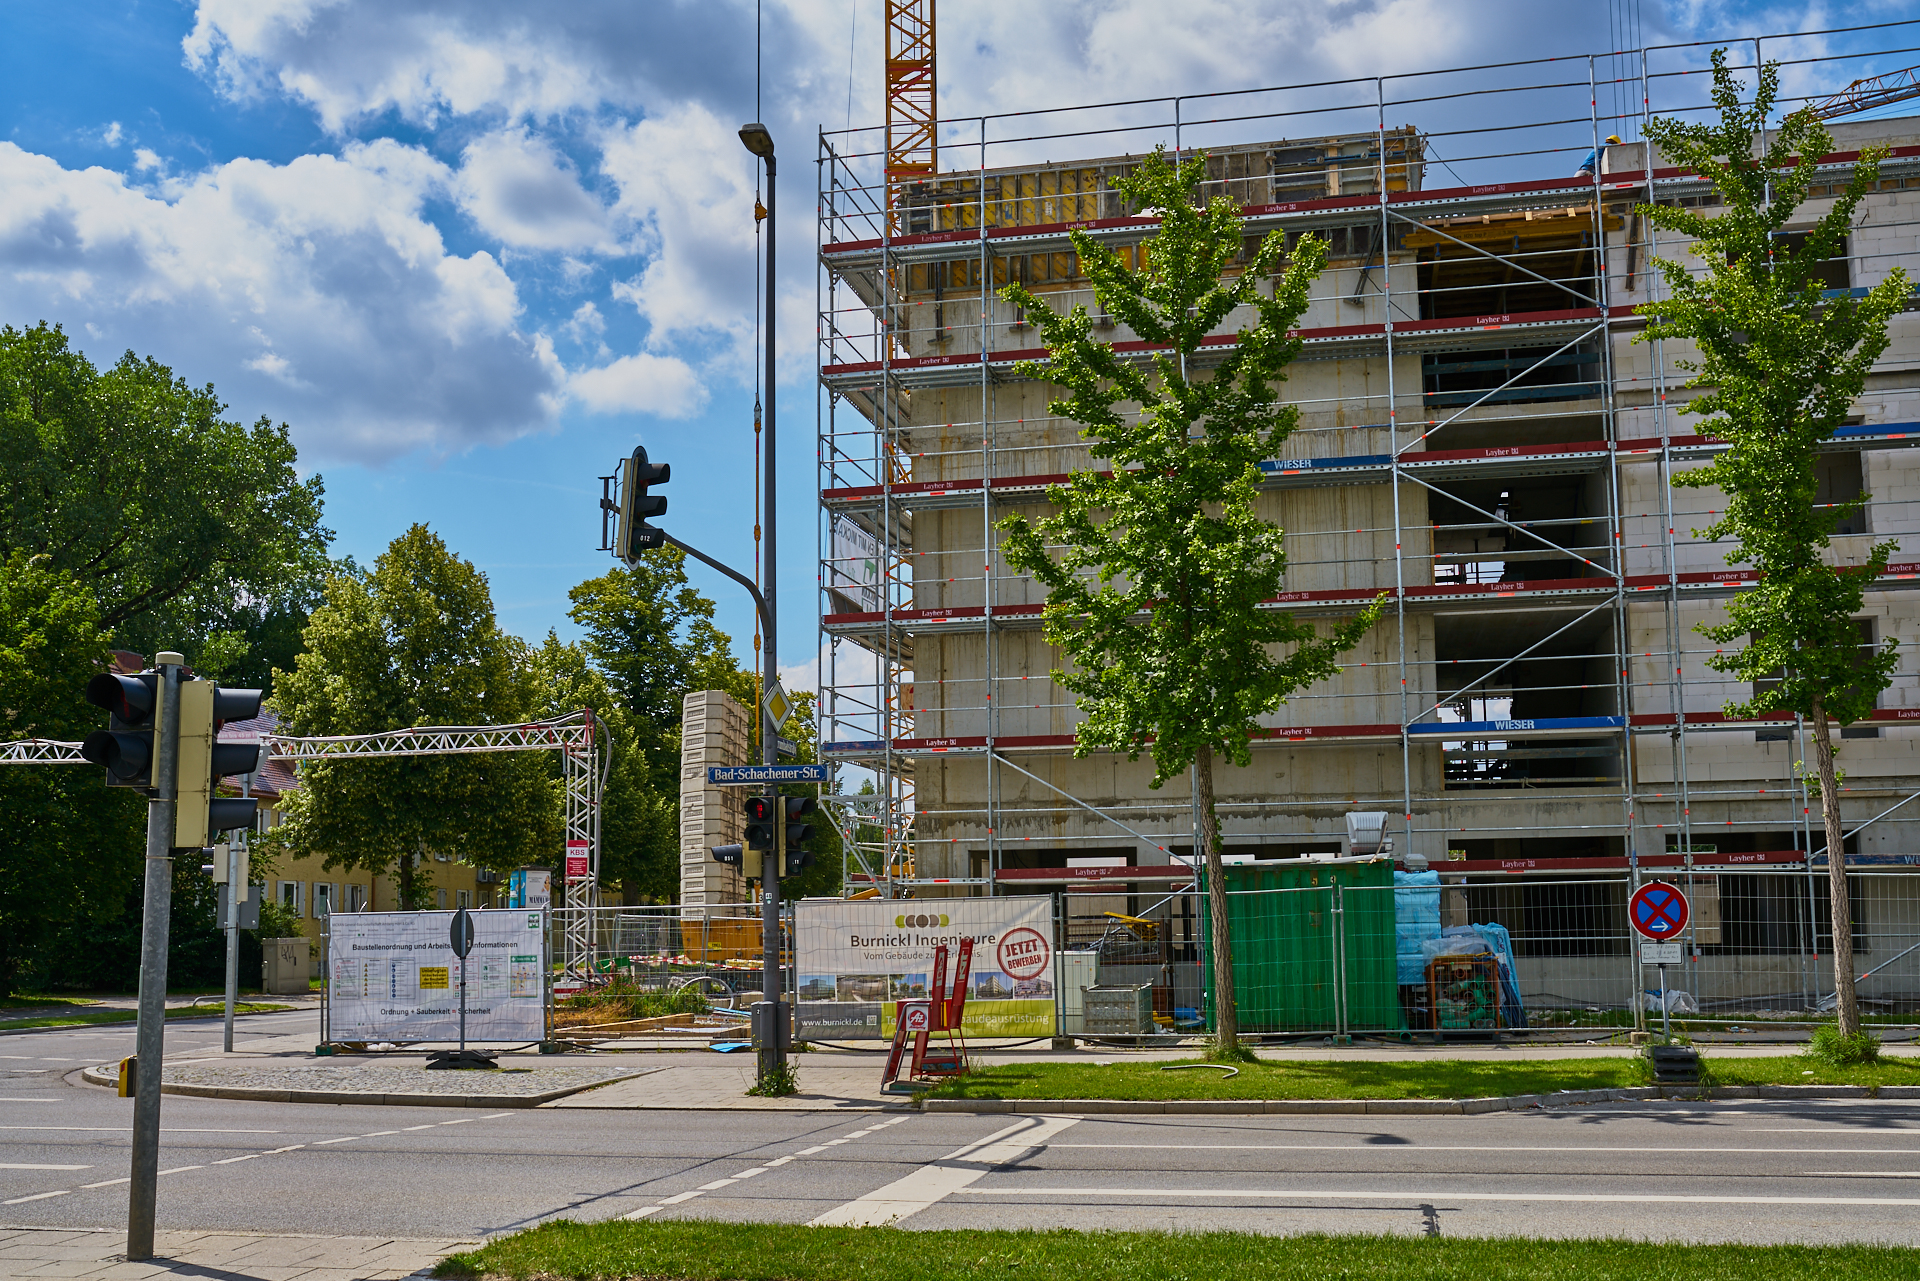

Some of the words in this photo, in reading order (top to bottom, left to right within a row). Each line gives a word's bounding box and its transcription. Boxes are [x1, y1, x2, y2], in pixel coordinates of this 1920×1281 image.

[1264, 204, 1288, 212] Layher
[1476, 317, 1500, 325] Layher
[1485, 449, 1510, 457] Layher
[1274, 459, 1312, 470] WIESER
[1887, 564, 1912, 573] Layher
[1490, 584, 1515, 592] Layher
[1494, 720, 1535, 730] WIESER
[714, 766, 820, 781] Bad-Schachener-Str.
[1729, 854, 1755, 862] Layher
[851, 933, 911, 947] Burnickl
[1005, 938, 1038, 957] JETZT
[885, 950, 923, 960] Gebäude
[1008, 954, 1042, 969] BEWERBEN
[380, 1008, 409, 1016] Ordnung
[801, 1018, 863, 1027] www.burnickl.de
